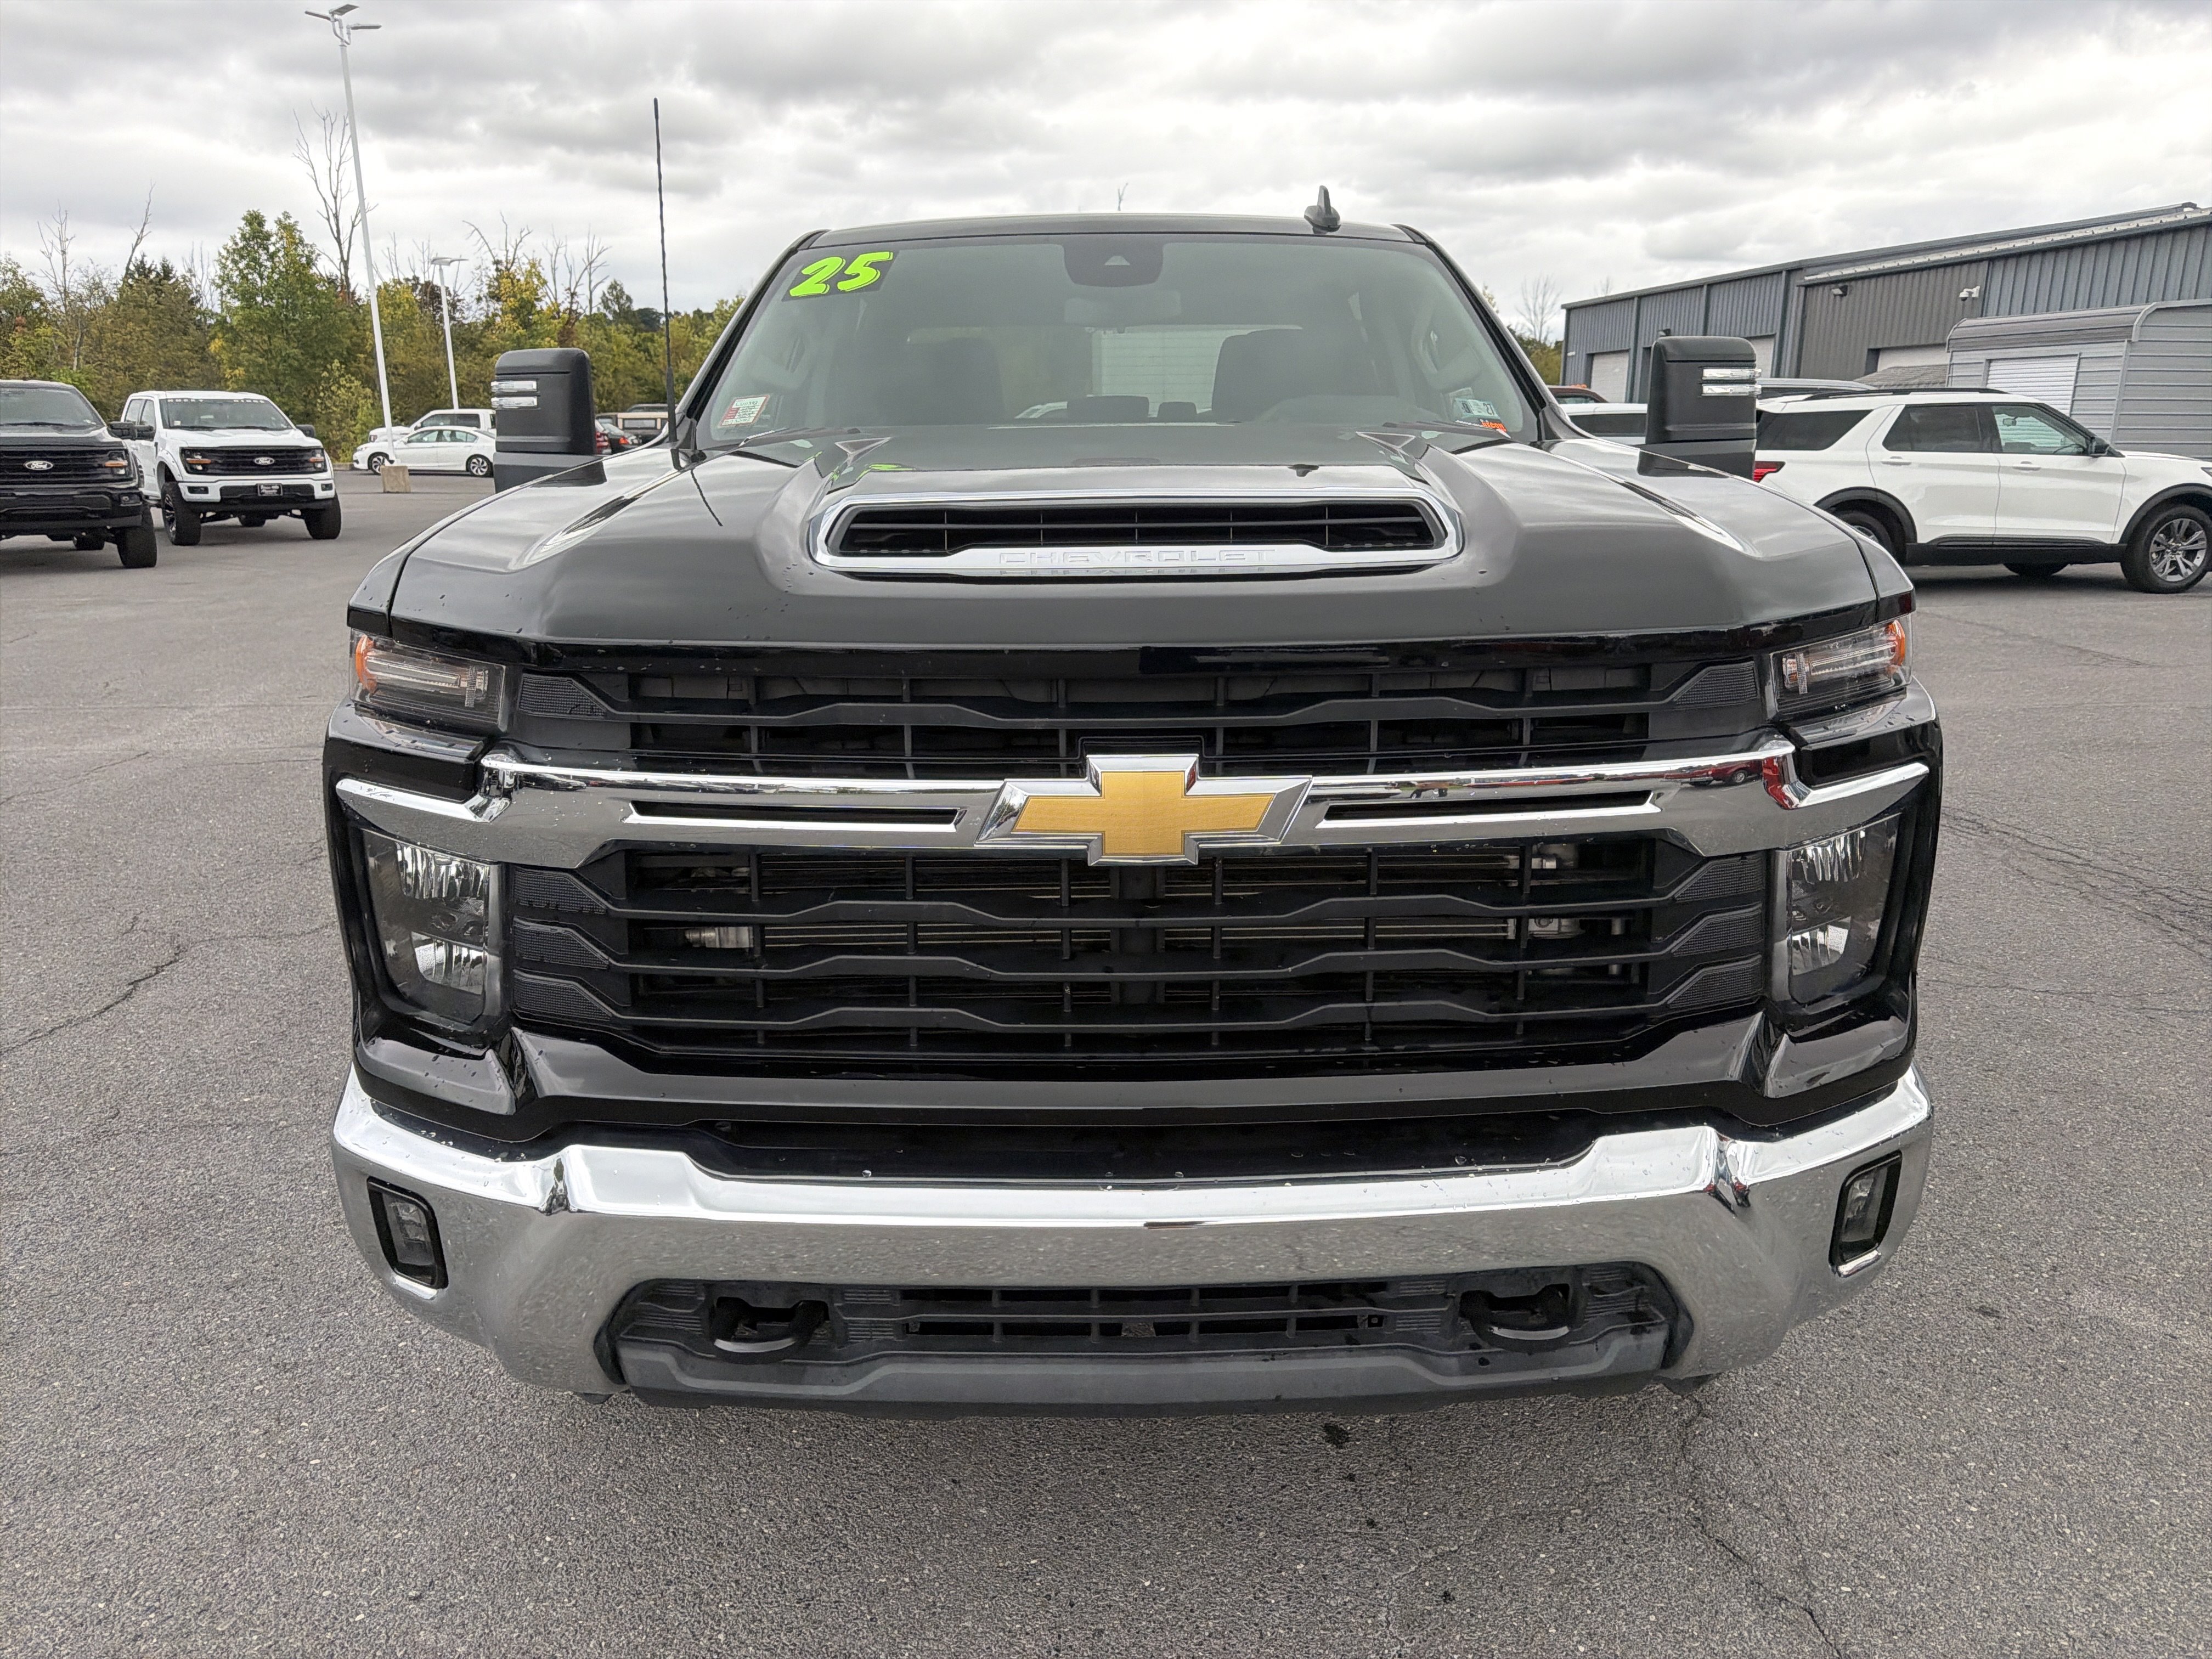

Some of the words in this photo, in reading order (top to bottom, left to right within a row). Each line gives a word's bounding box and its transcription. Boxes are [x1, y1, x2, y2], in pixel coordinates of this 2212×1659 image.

[789, 251, 894, 297] 25
[1483, 403, 1494, 415] 27
[1000, 549, 1276, 563] CHEVROLET
